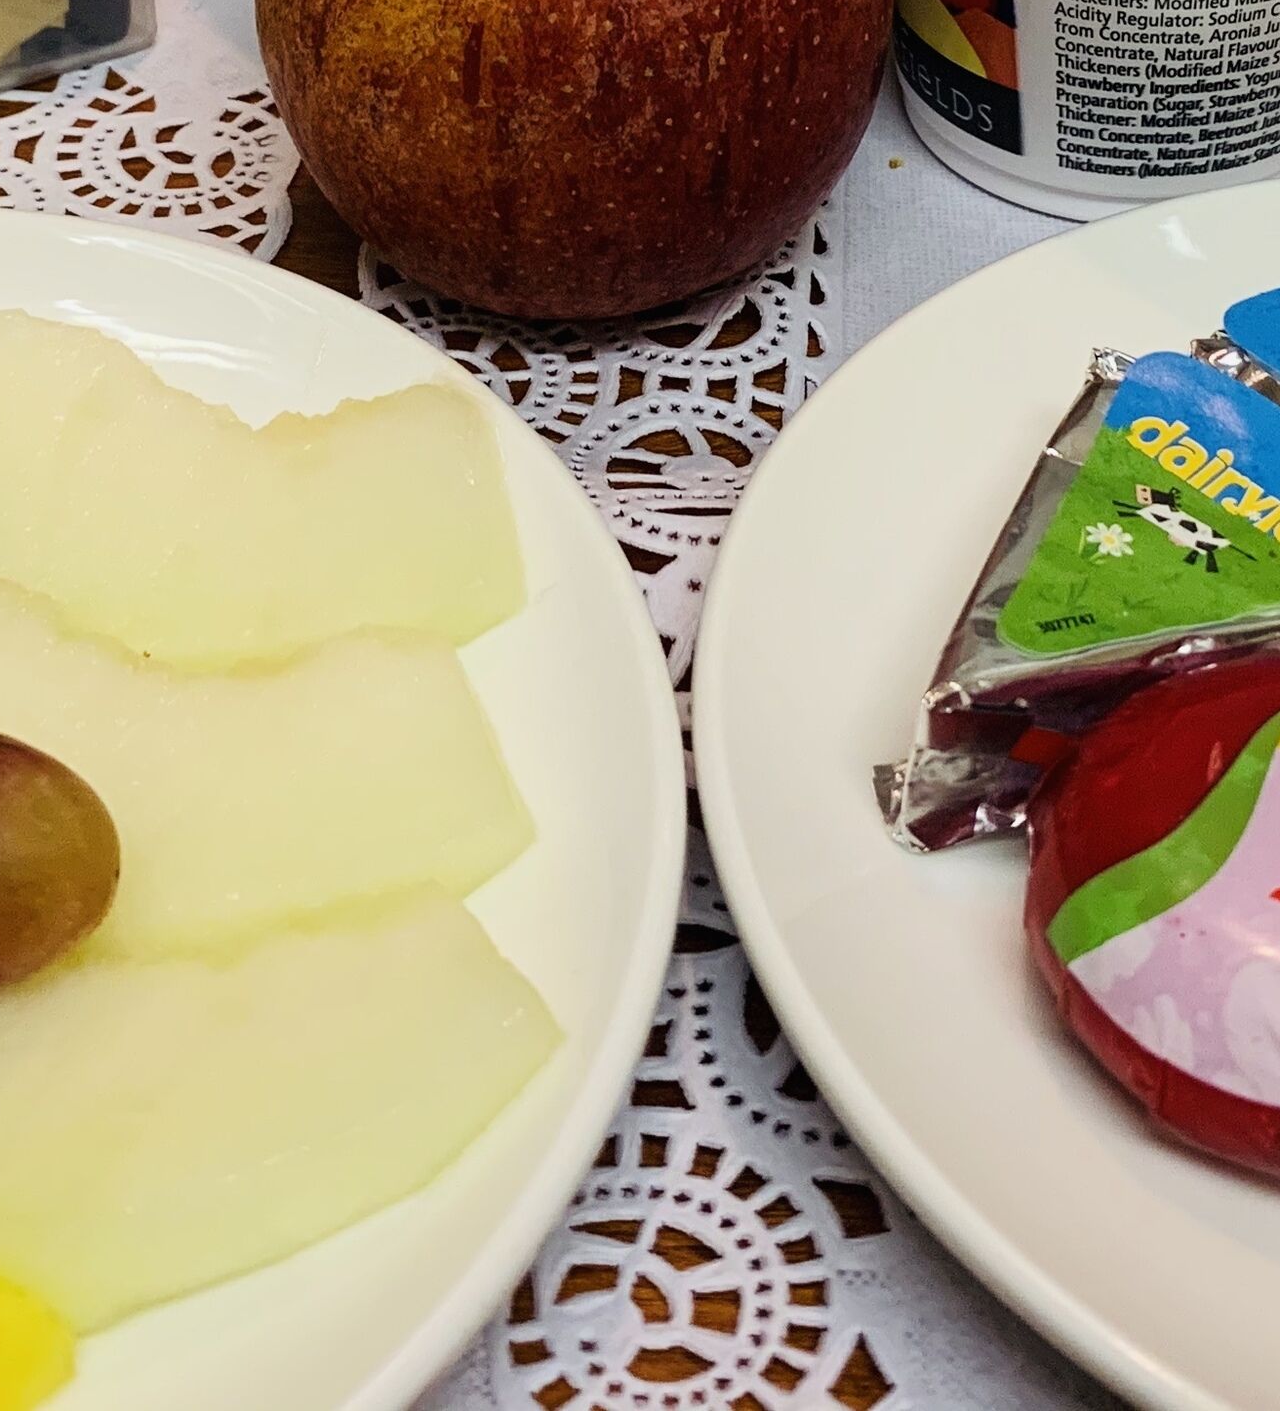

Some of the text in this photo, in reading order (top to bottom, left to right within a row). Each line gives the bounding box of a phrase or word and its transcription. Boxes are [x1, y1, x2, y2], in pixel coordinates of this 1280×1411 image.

[1054, 1, 1266, 30] Acidity Regulator: Sodium
[1054, 17, 1094, 38] from
[1099, 26, 1204, 45] Concentrate,
[1208, 24, 1261, 43] Aronia
[1055, 36, 1159, 63] Concentrate,
[1164, 43, 1224, 62] Natural
[1055, 52, 1271, 80] Thickeners (Modified Maize
[1056, 70, 1145, 97] Strawberry
[1056, 87, 1148, 111] Preparation
[1056, 120, 1095, 140] from
[1140, 112, 1210, 128] Modified
